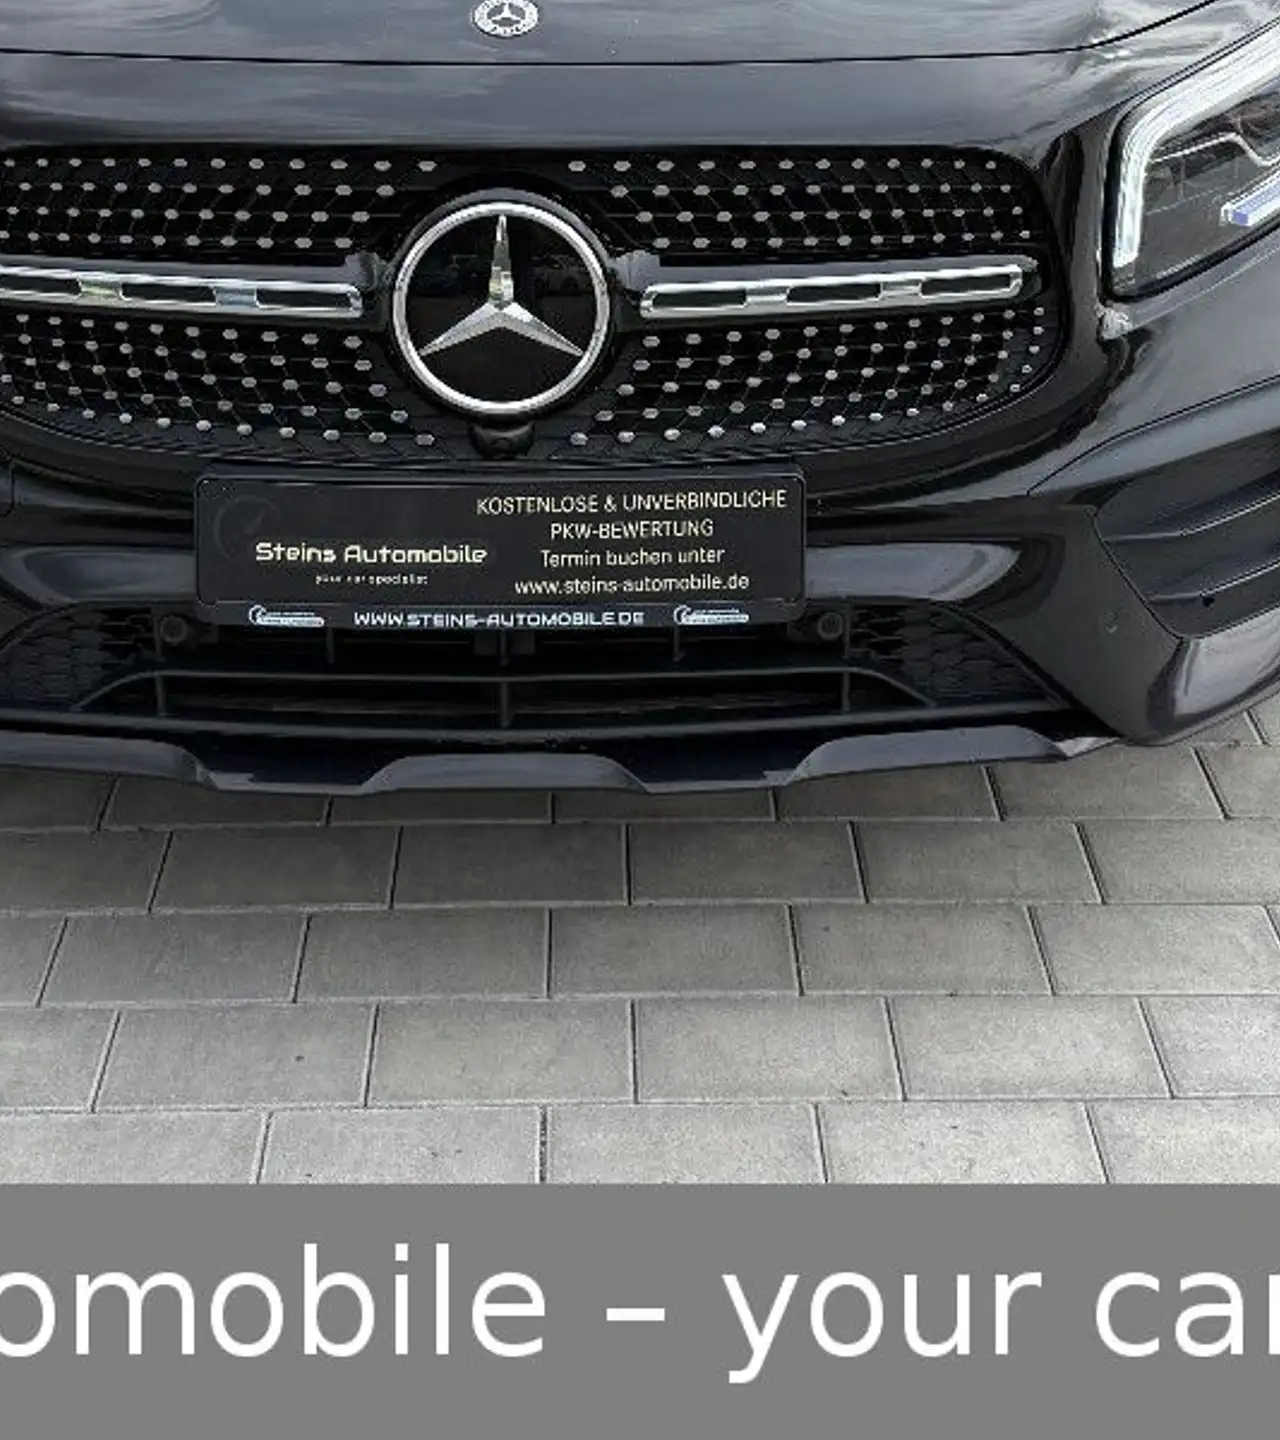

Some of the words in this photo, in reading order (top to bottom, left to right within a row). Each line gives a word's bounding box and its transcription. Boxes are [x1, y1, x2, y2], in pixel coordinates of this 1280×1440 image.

[476, 493, 599, 515] KOSTENLOSE
[604, 495, 617, 513] &
[622, 489, 788, 512] UNVERBINDLICHE
[550, 518, 714, 540] PKW-BEWERTUNG
[255, 541, 337, 564] Steins
[344, 544, 488, 564] Automobile
[540, 549, 601, 568] Termin
[606, 547, 673, 566] buchen
[678, 547, 726, 564] unter
[514, 573, 750, 595] www.steins-automobile.de
[353, 611, 646, 628] WWW.STEINS-AUTOMOBILE.DE
